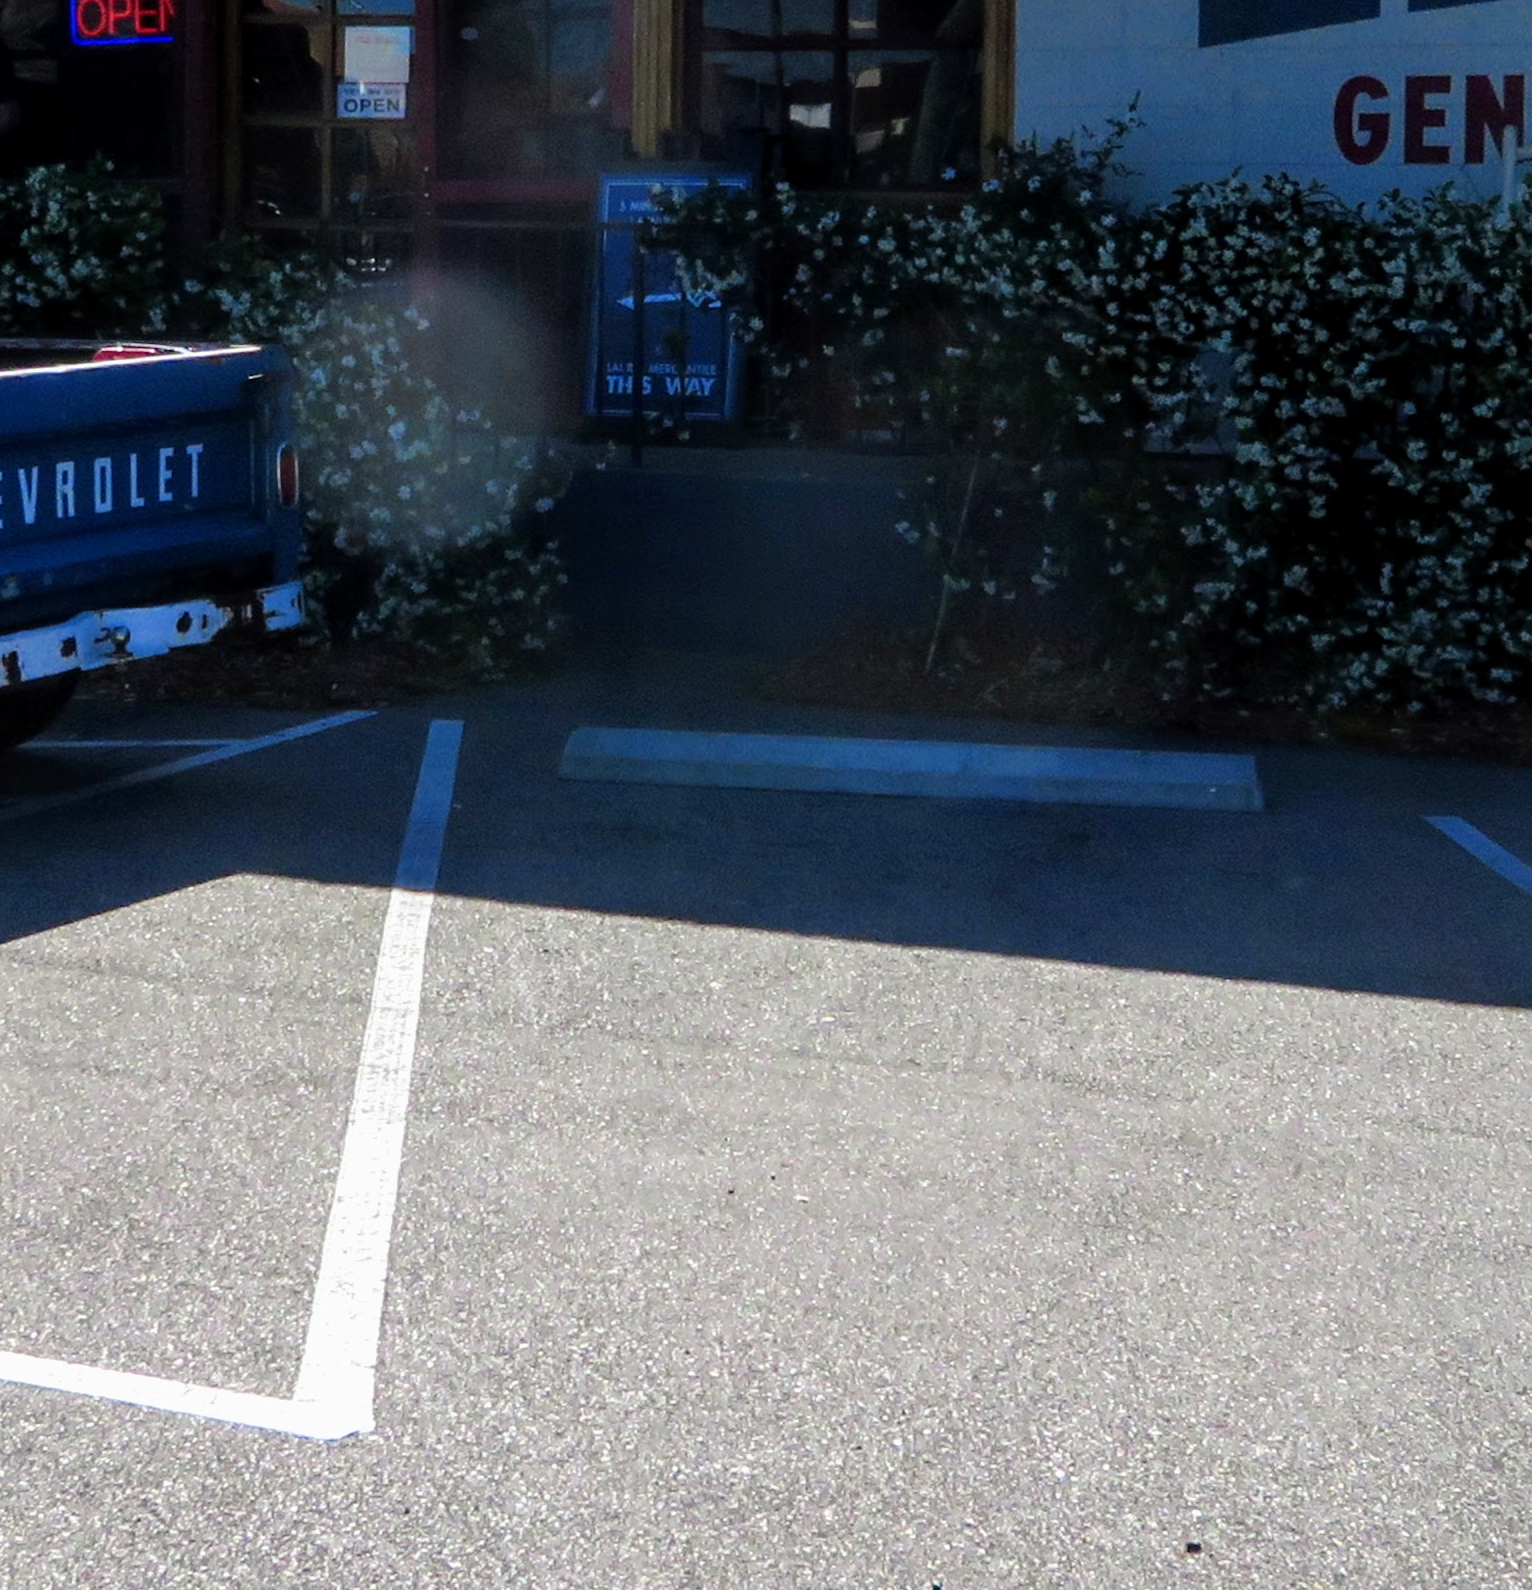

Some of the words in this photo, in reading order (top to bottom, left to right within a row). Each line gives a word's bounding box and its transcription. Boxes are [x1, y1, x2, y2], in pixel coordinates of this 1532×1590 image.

[343, 98, 401, 113] OPEN
[606, 375, 653, 395] THS
[665, 376, 717, 397] WAY
